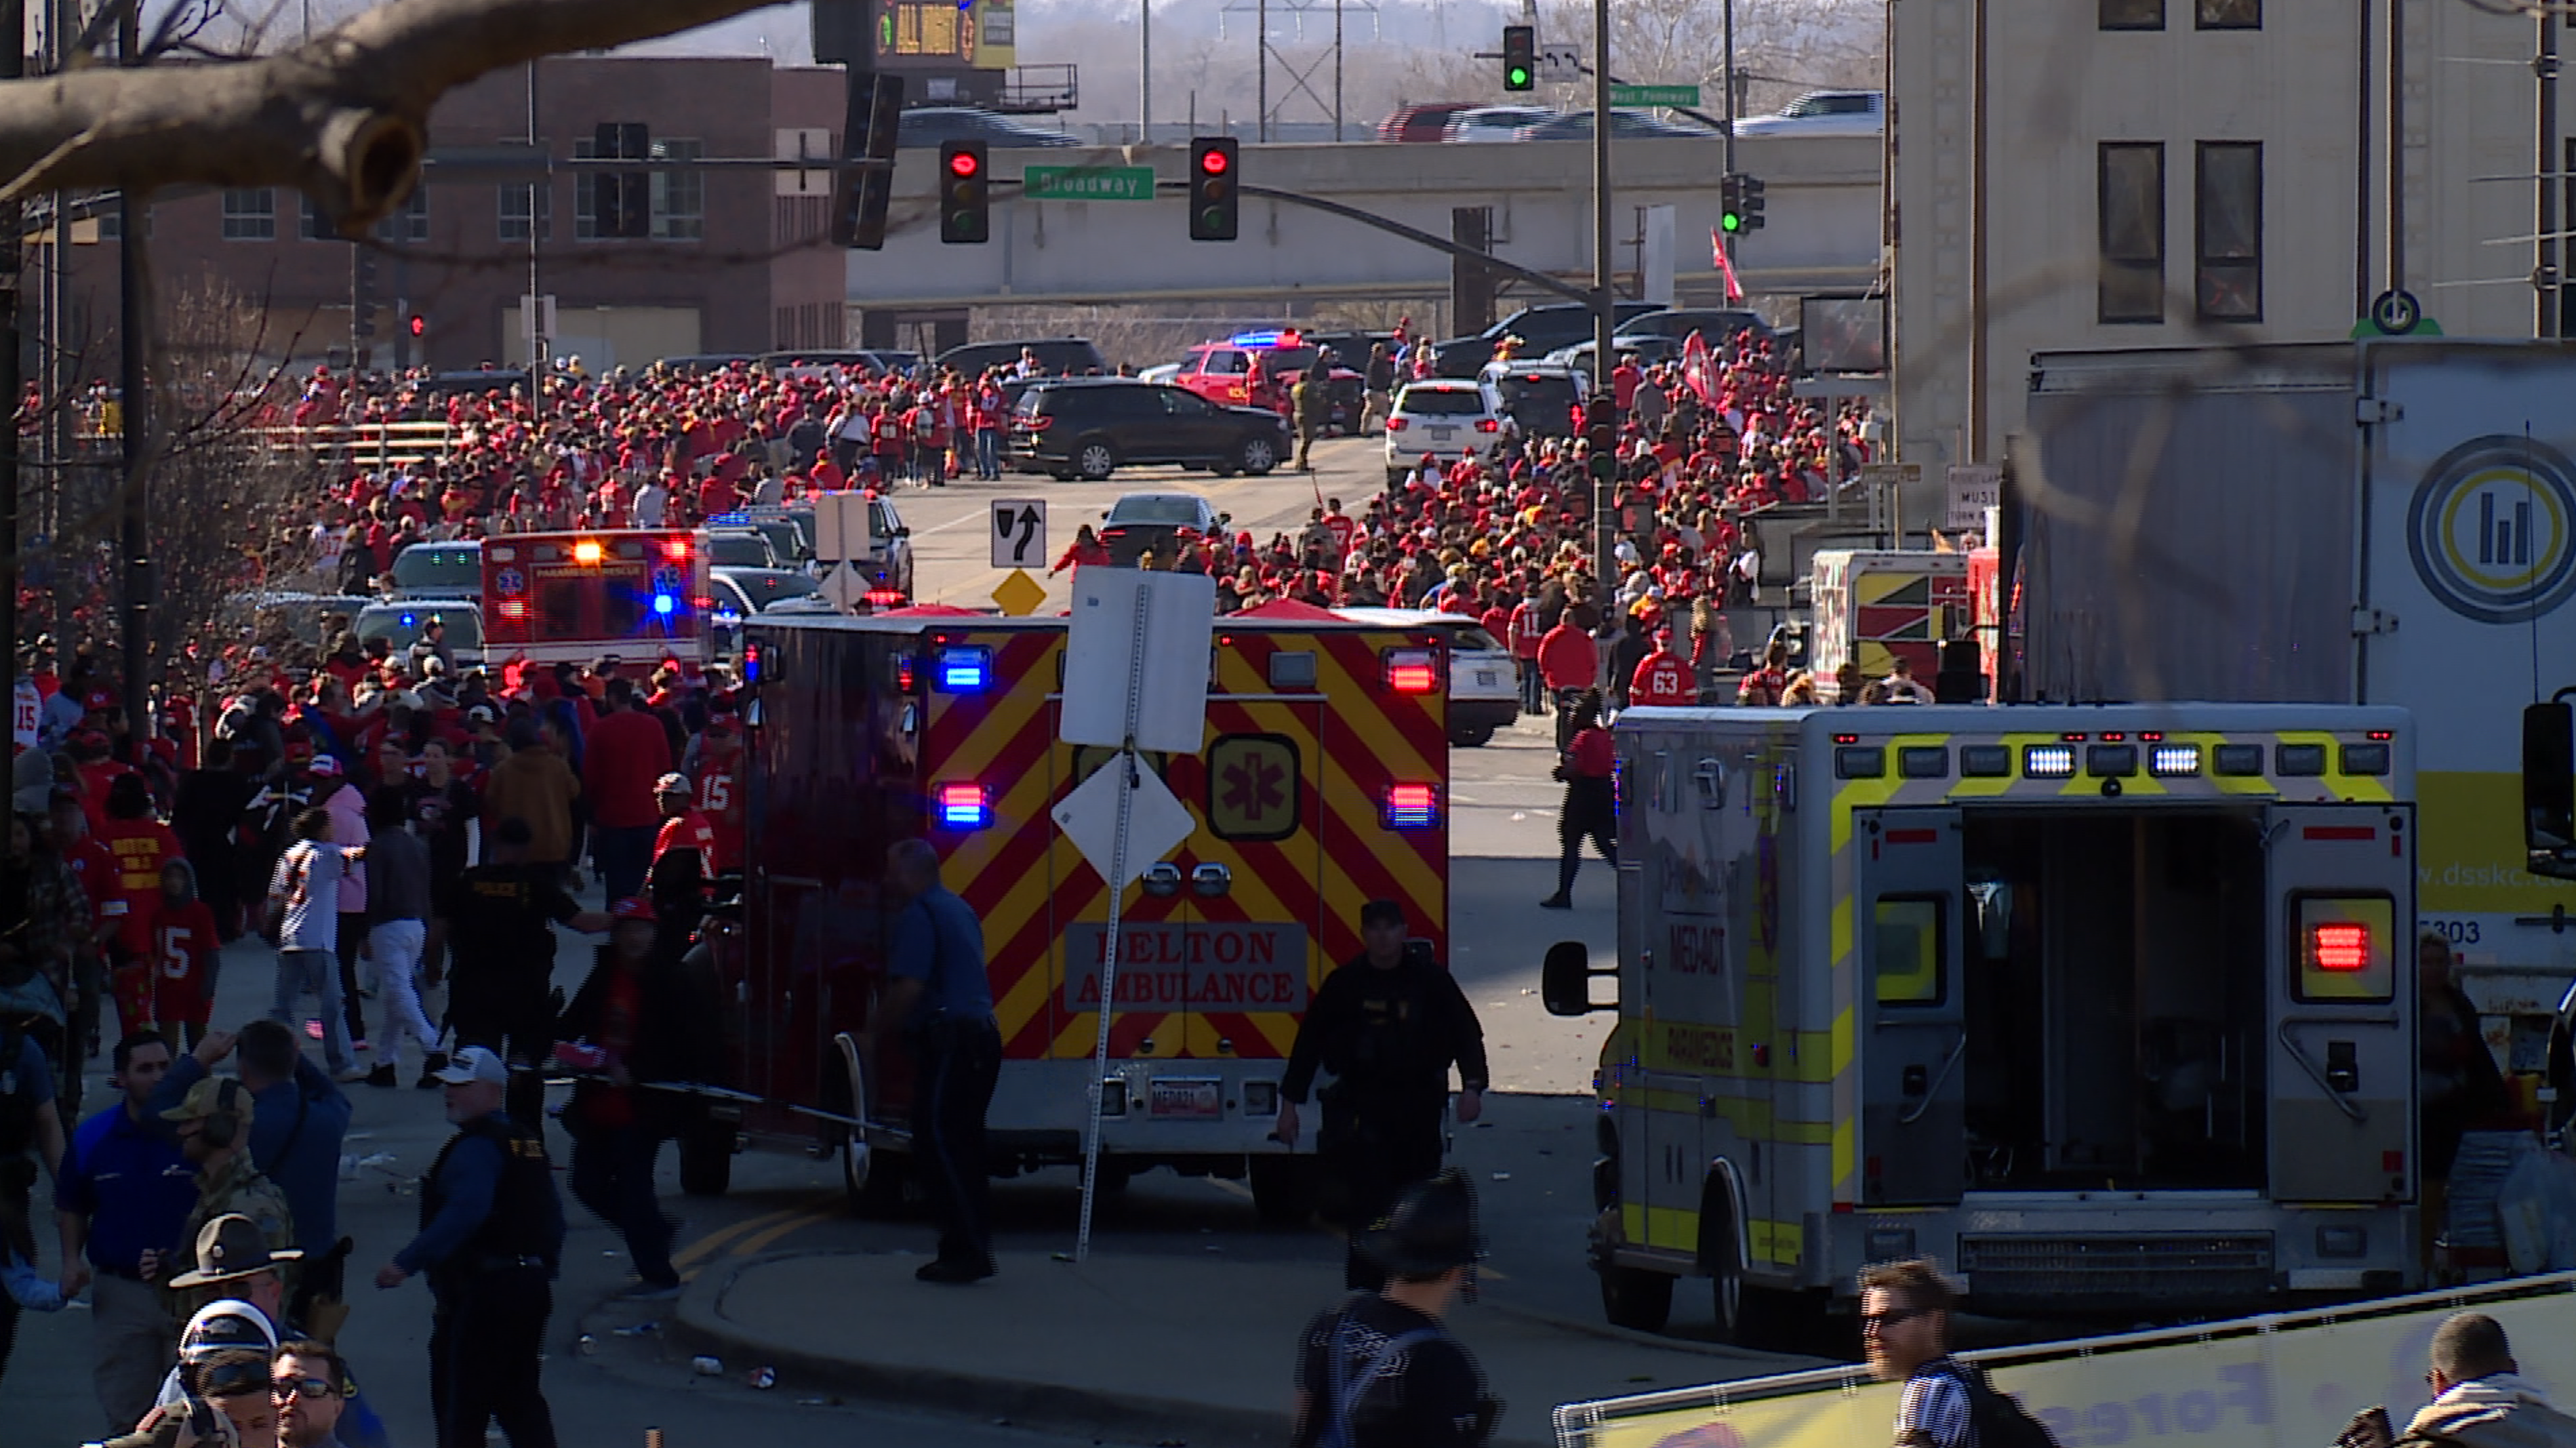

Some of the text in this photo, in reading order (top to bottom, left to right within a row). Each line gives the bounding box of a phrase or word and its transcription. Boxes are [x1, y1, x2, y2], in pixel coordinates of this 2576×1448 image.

[1041, 172, 1138, 197] Broadway
[1962, 491, 1996, 505] MUST
[601, 567, 641, 576] RESCUE
[1653, 670, 1678, 695] 63
[18, 704, 35, 731] 15
[702, 772, 733, 811] 15
[2419, 920, 2480, 944] 303
[1097, 932, 1276, 963] BELTON
[1669, 924, 1725, 975] MED-ACT
[1079, 973, 1293, 1003] AMBULANCE
[1667, 1027, 1733, 1068] PARAMEDICS
